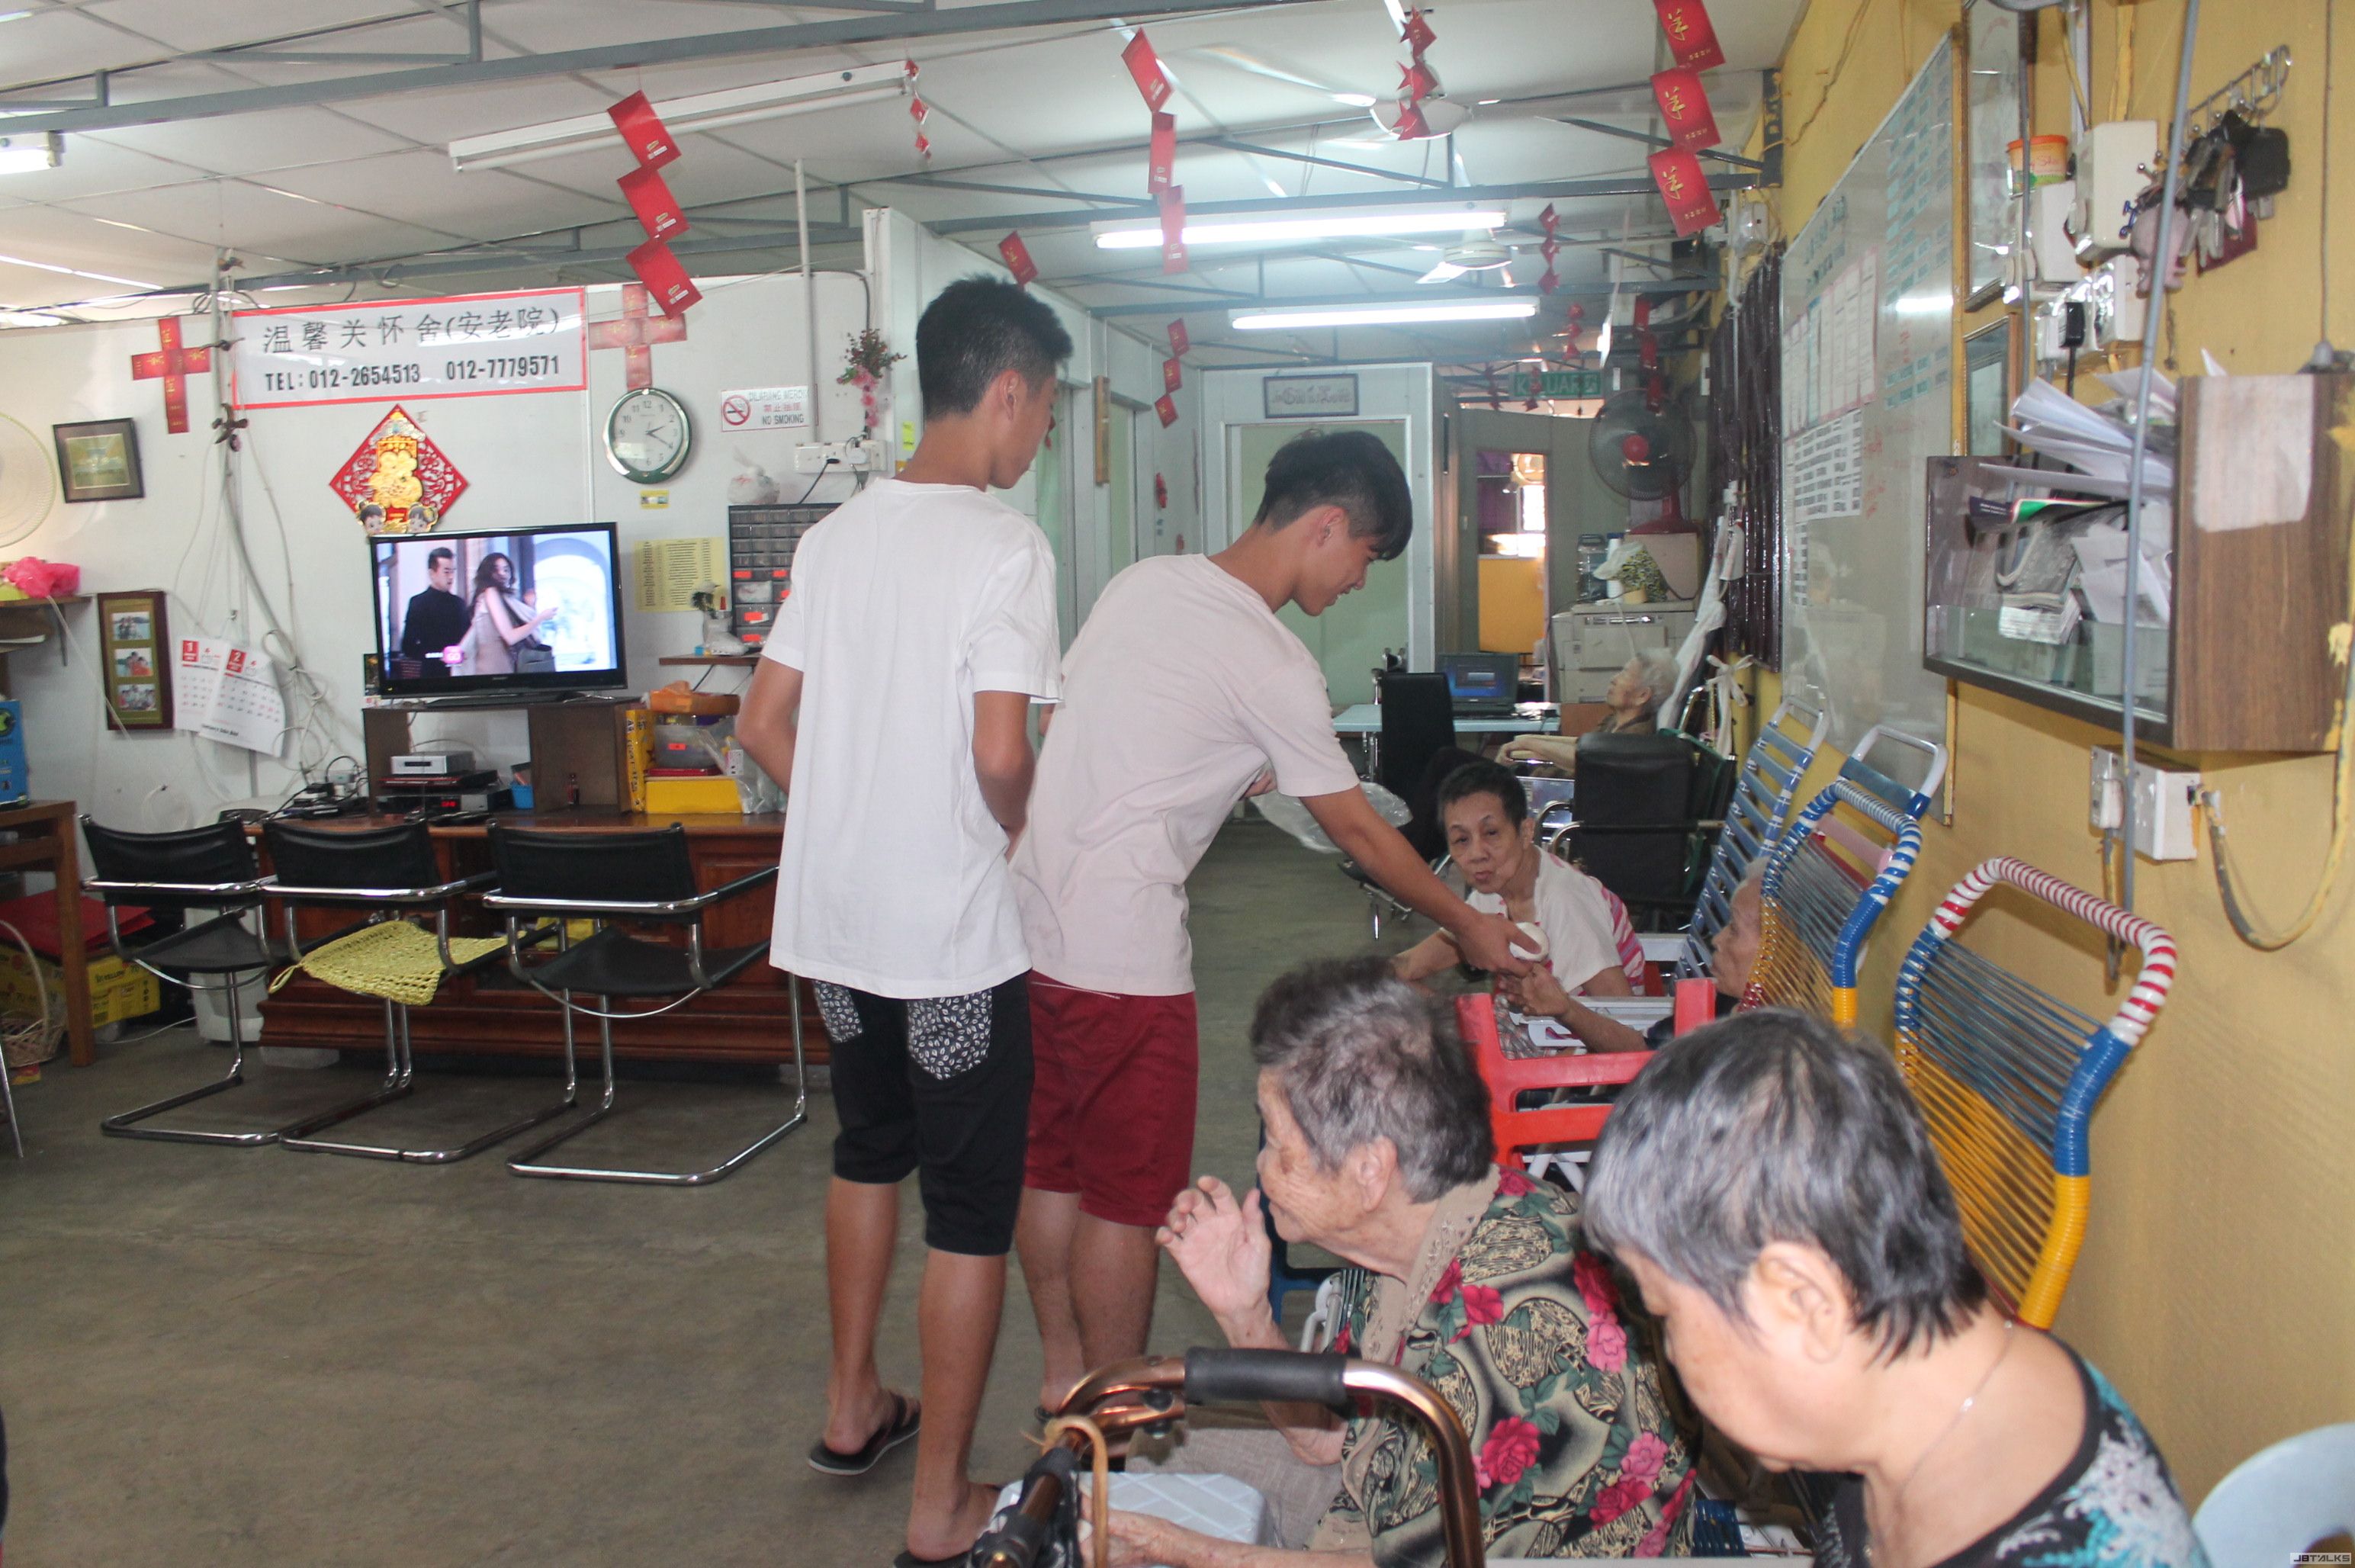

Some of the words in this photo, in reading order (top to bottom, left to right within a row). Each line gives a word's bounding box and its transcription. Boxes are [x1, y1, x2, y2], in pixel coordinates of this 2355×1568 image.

[446, 355, 560, 381] 012-7779571
[763, 416, 771, 425] NO
[775, 414, 805, 424] SMOKING
[186, 642, 193, 652] 1
[233, 652, 242, 662] 2
